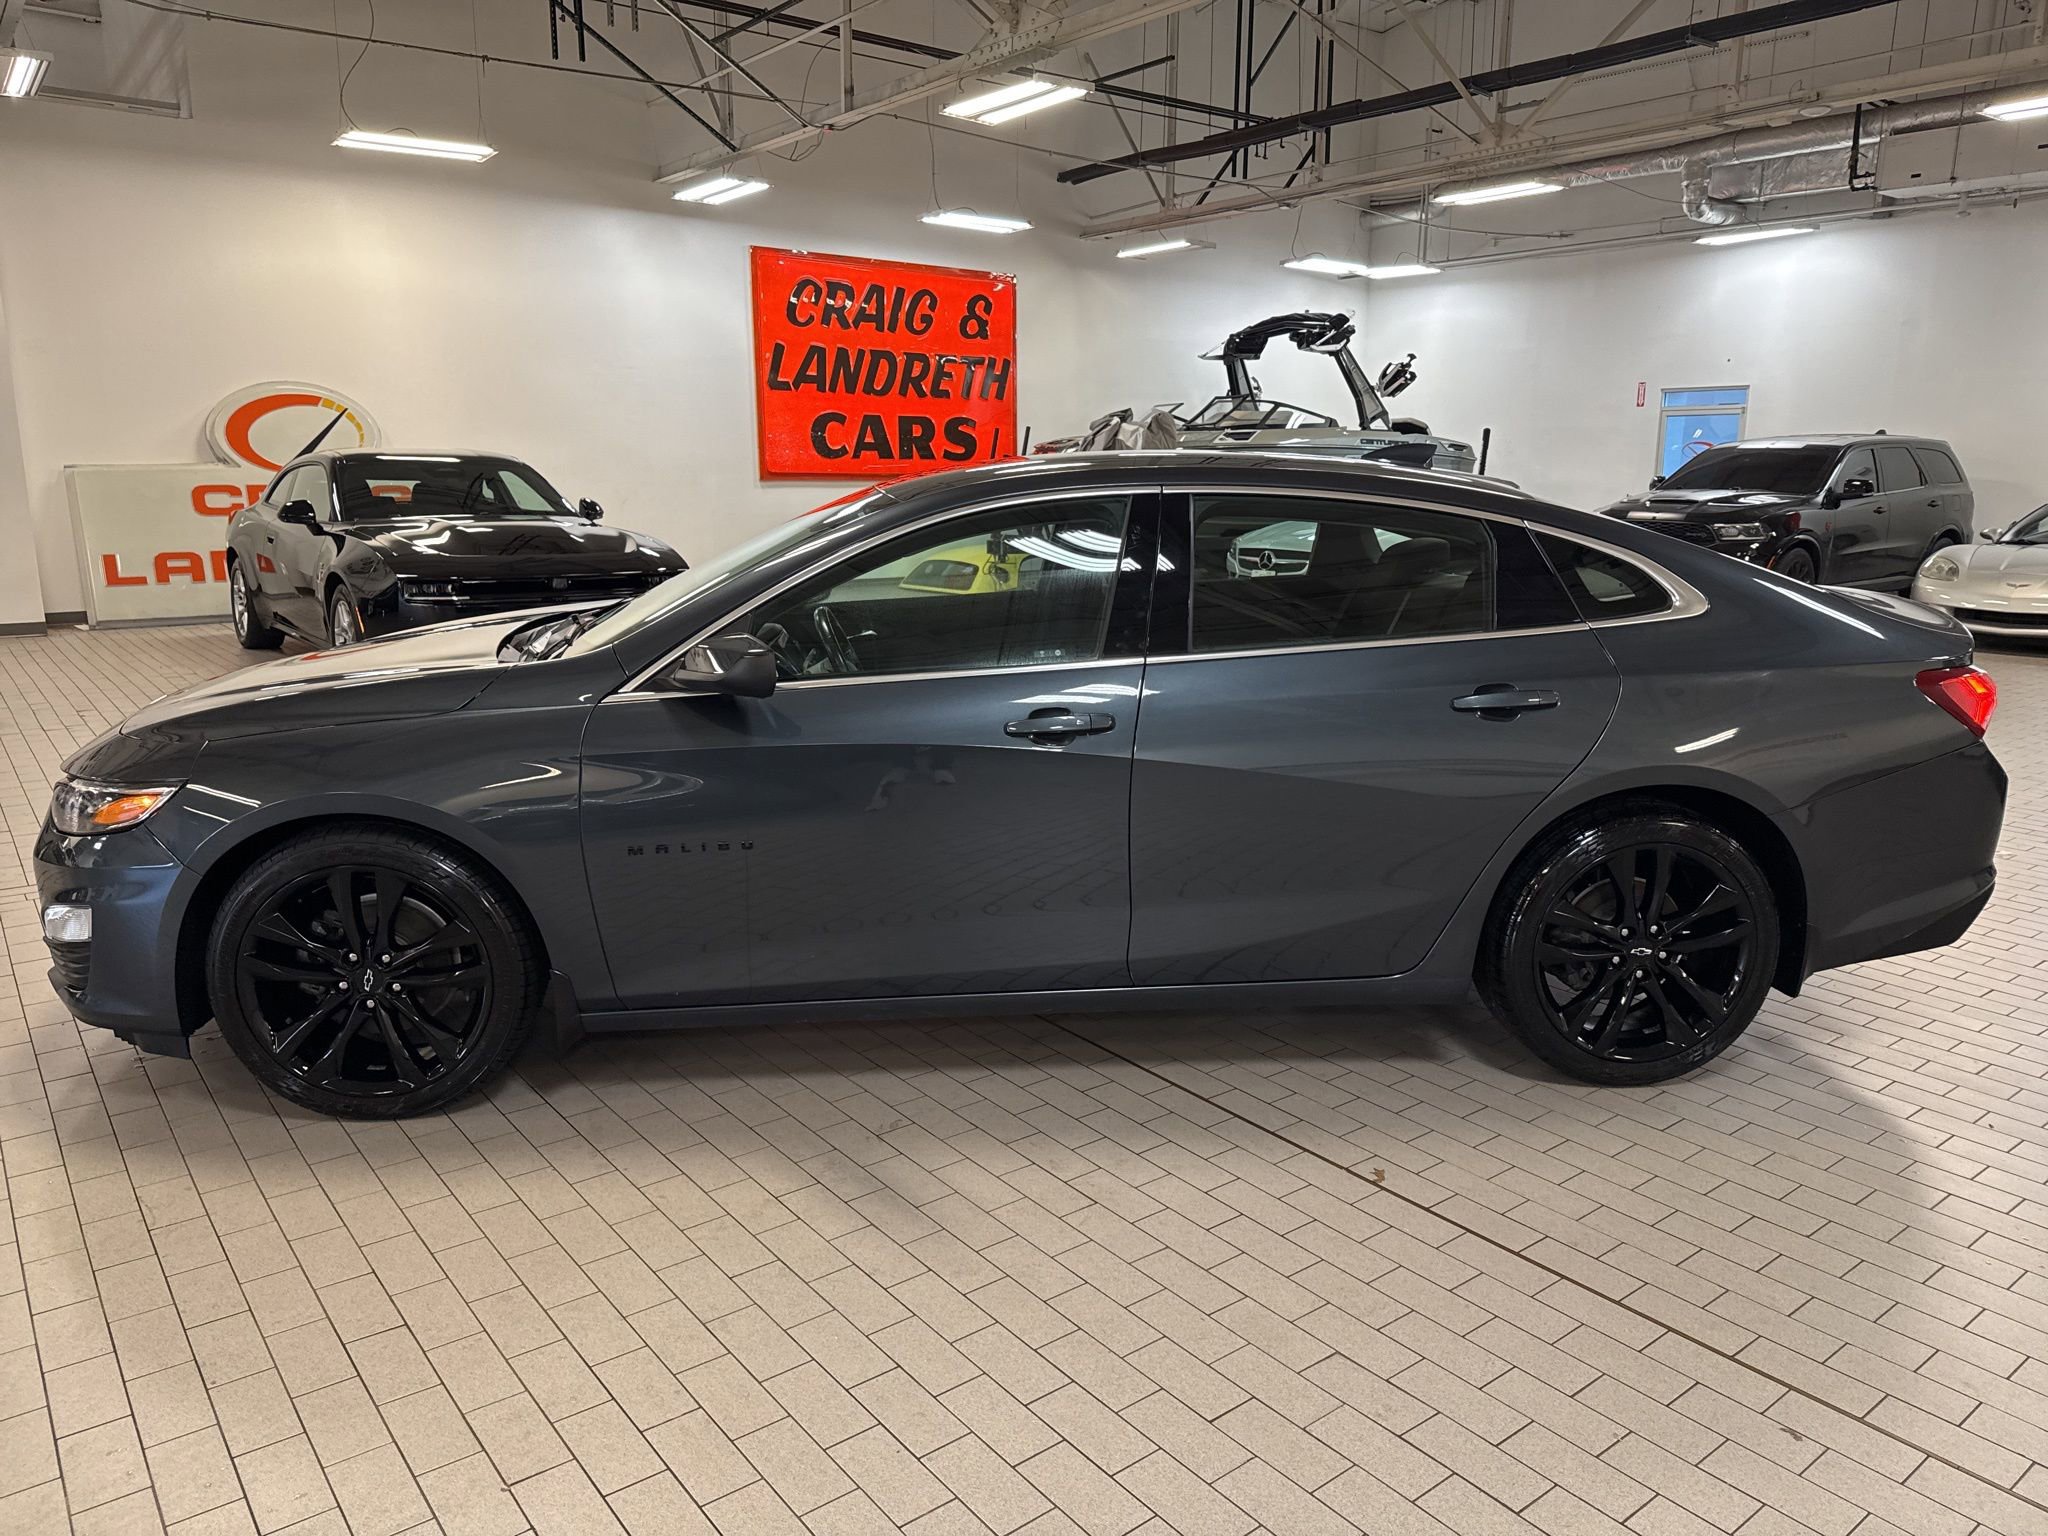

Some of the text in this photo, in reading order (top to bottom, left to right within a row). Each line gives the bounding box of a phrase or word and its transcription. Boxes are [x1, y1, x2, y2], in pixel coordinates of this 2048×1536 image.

[786, 277, 993, 340] CRAIG &
[767, 343, 1011, 401] LANDRETH
[811, 412, 978, 461] CARS
[627, 840, 754, 856] MALIBU
